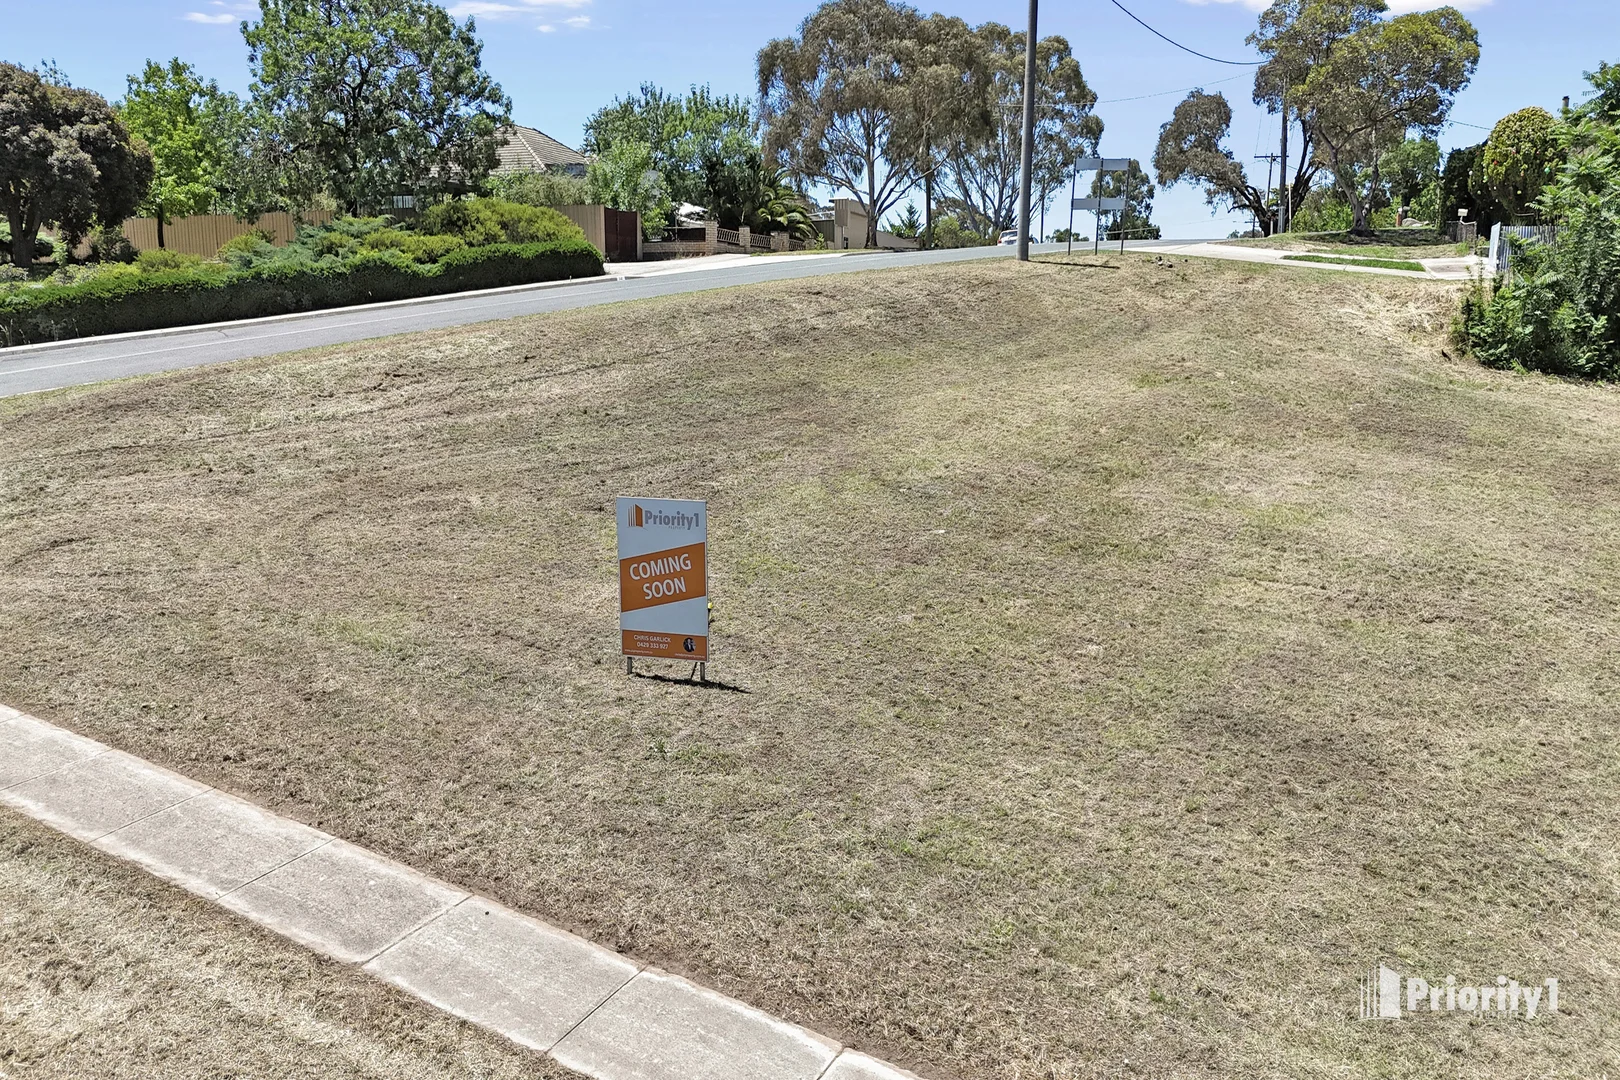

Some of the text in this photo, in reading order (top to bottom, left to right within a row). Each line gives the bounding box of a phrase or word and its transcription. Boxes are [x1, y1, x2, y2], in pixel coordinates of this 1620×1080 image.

[645, 510, 699, 530] Priority1
[629, 553, 692, 580] COMING
[643, 576, 686, 600] SOON
[650, 635, 671, 643] GARLICK
